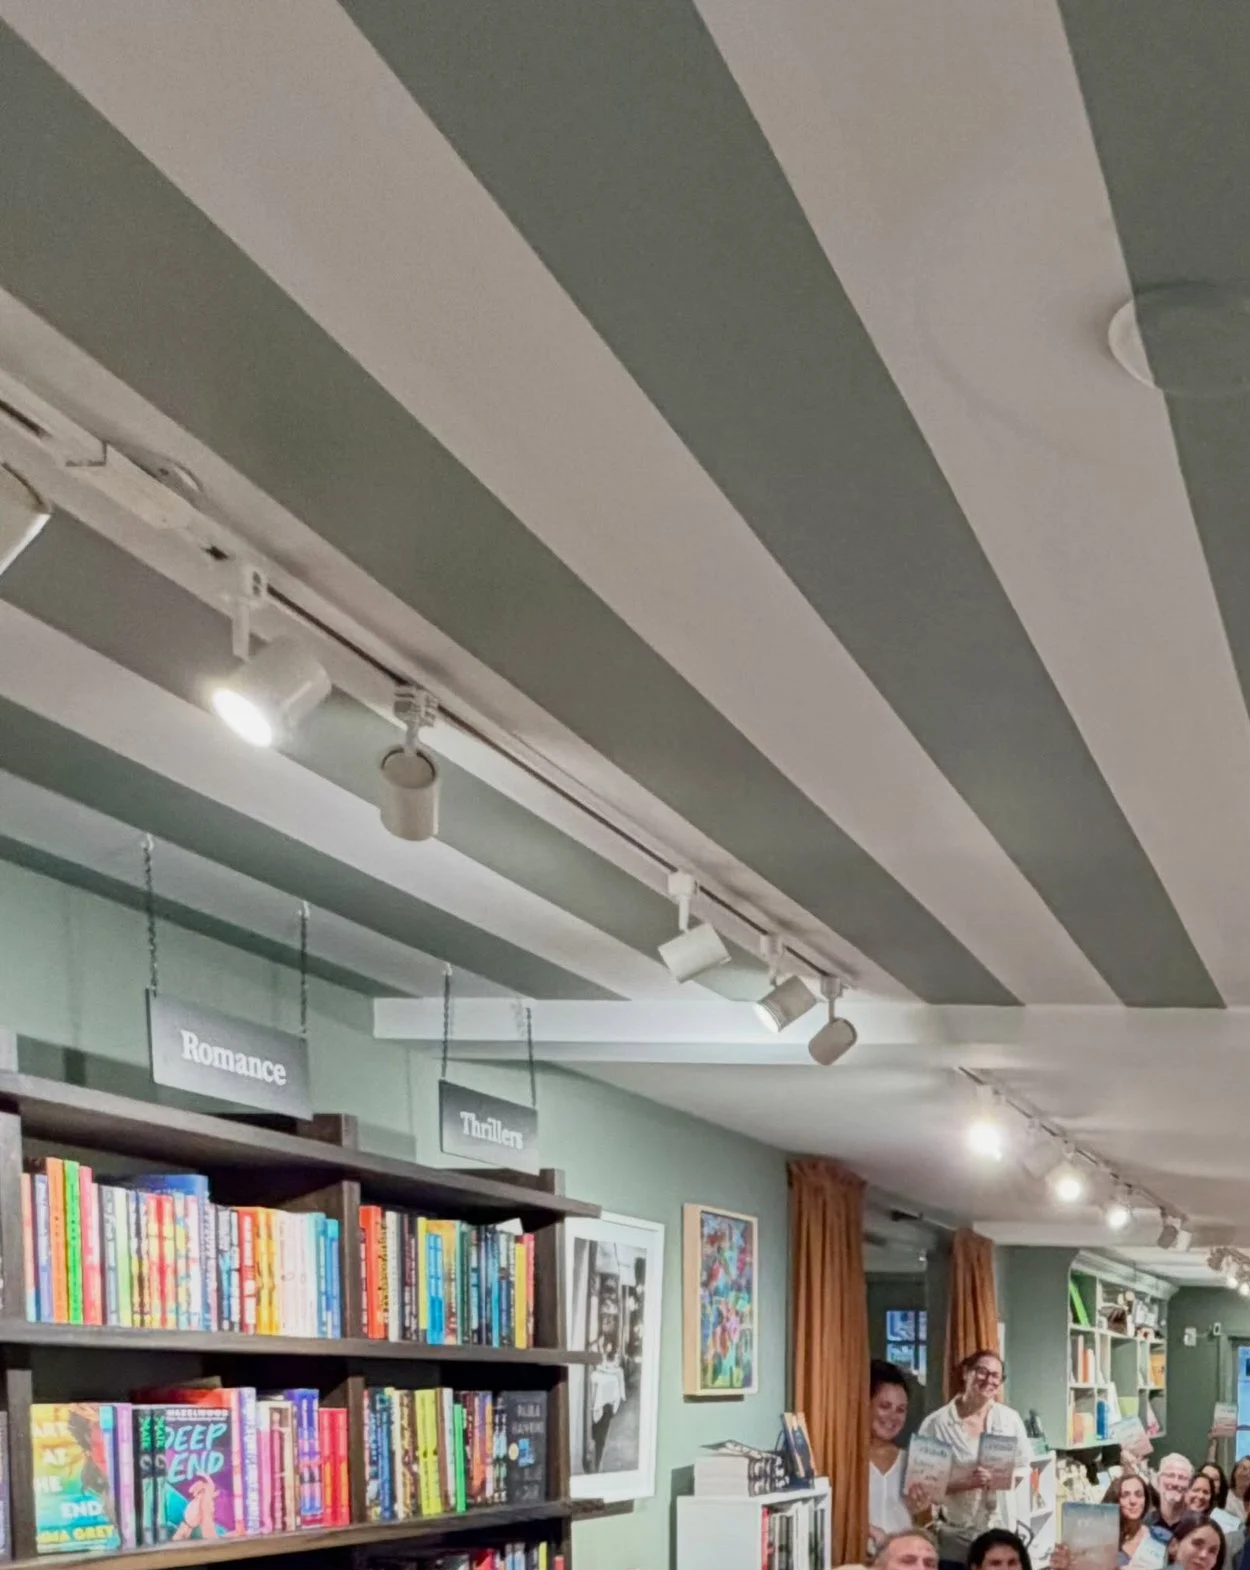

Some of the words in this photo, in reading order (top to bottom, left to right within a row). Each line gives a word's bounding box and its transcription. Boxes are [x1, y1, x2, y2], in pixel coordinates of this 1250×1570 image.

[180, 1029, 287, 1086] Romance
[459, 1111, 524, 1150] Thrillers
[165, 1423, 228, 1449] DEEP
[166, 1451, 225, 1483] END
